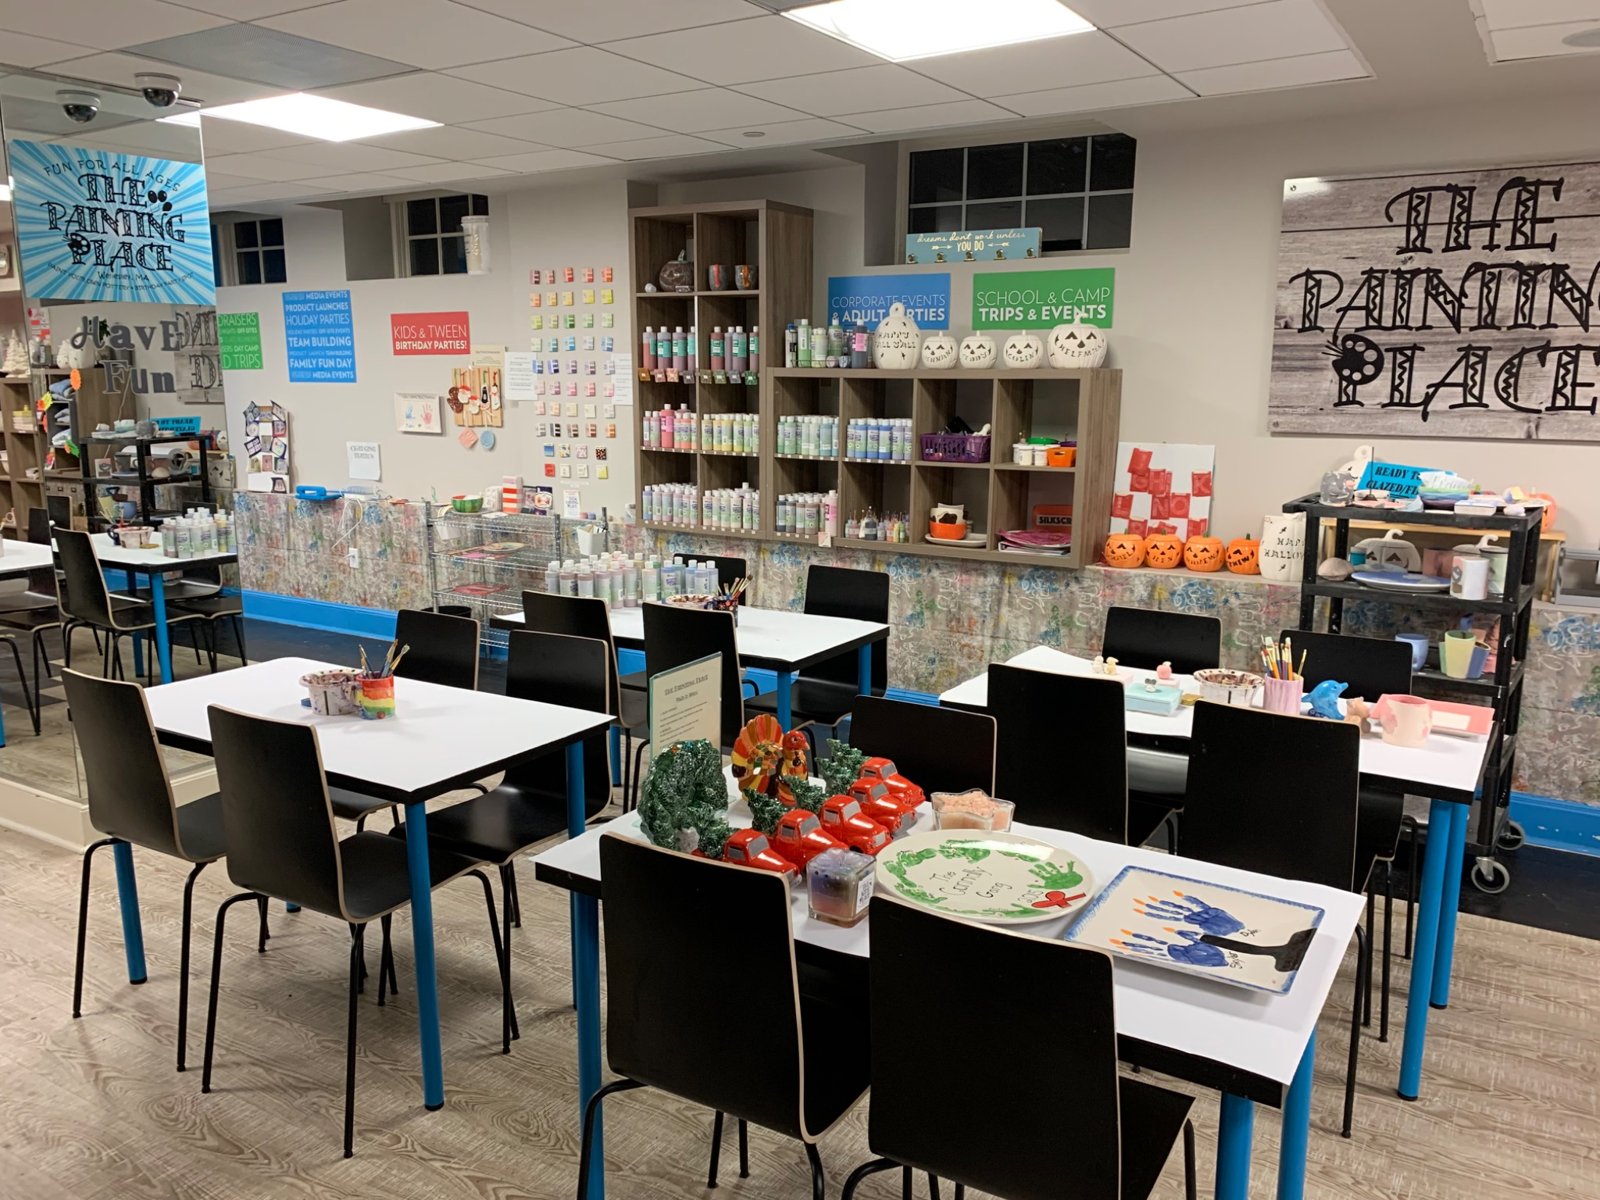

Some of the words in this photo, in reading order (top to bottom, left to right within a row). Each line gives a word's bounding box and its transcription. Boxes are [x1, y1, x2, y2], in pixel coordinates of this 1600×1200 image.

[44, 162, 73, 176] FUN
[77, 159, 107, 170] FOR
[111, 162, 139, 176] ALL
[145, 171, 182, 192] AGES
[77, 172, 147, 208] THE
[39, 201, 186, 243] PAINTING
[1385, 176, 1564, 255] THE
[996, 230, 1026, 239] unless
[68, 233, 173, 273] PLACE
[956, 242, 972, 252] YOU
[974, 241, 985, 251] DO
[306, 292, 325, 300] MEDIA
[325, 291, 348, 299] EVENTS
[901, 295, 946, 307] EVENTS
[976, 290, 1044, 306] SCHOOL
[1047, 292, 1057, 303] &
[1062, 287, 1110, 303] CAMP
[285, 303, 315, 312] PRODUCT
[315, 302, 349, 311] LAUNCHES
[1288, 261, 1600, 345] PAINTIN
[286, 315, 319, 326] HOLIDAY
[320, 313, 350, 324] PARTIES
[832, 312, 839, 320] &
[842, 309, 885, 322] ADULT
[906, 308, 945, 321] RTIES
[979, 307, 1023, 321] TRIPS
[1027, 309, 1037, 320] &
[1041, 305, 1106, 320] EVENTS
[393, 325, 417, 339] KIDS
[419, 328, 426, 338] &
[427, 324, 467, 338] TWEEN
[288, 338, 310, 347] TEAM
[311, 336, 352, 347] BUILDING
[395, 341, 432, 350] BIRTHDAY
[434, 340, 467, 349] PARTIES!
[234, 354, 261, 368] TRIPS
[290, 359, 318, 368] FAMILY
[319, 359, 335, 368] FUN
[336, 358, 353, 368] DAY
[99, 360, 176, 393] Fun
[312, 371, 331, 379] MEDIA
[331, 371, 354, 379] EVENTS
[1331, 334, 1600, 422] PLACE
[1375, 467, 1408, 479] READY
